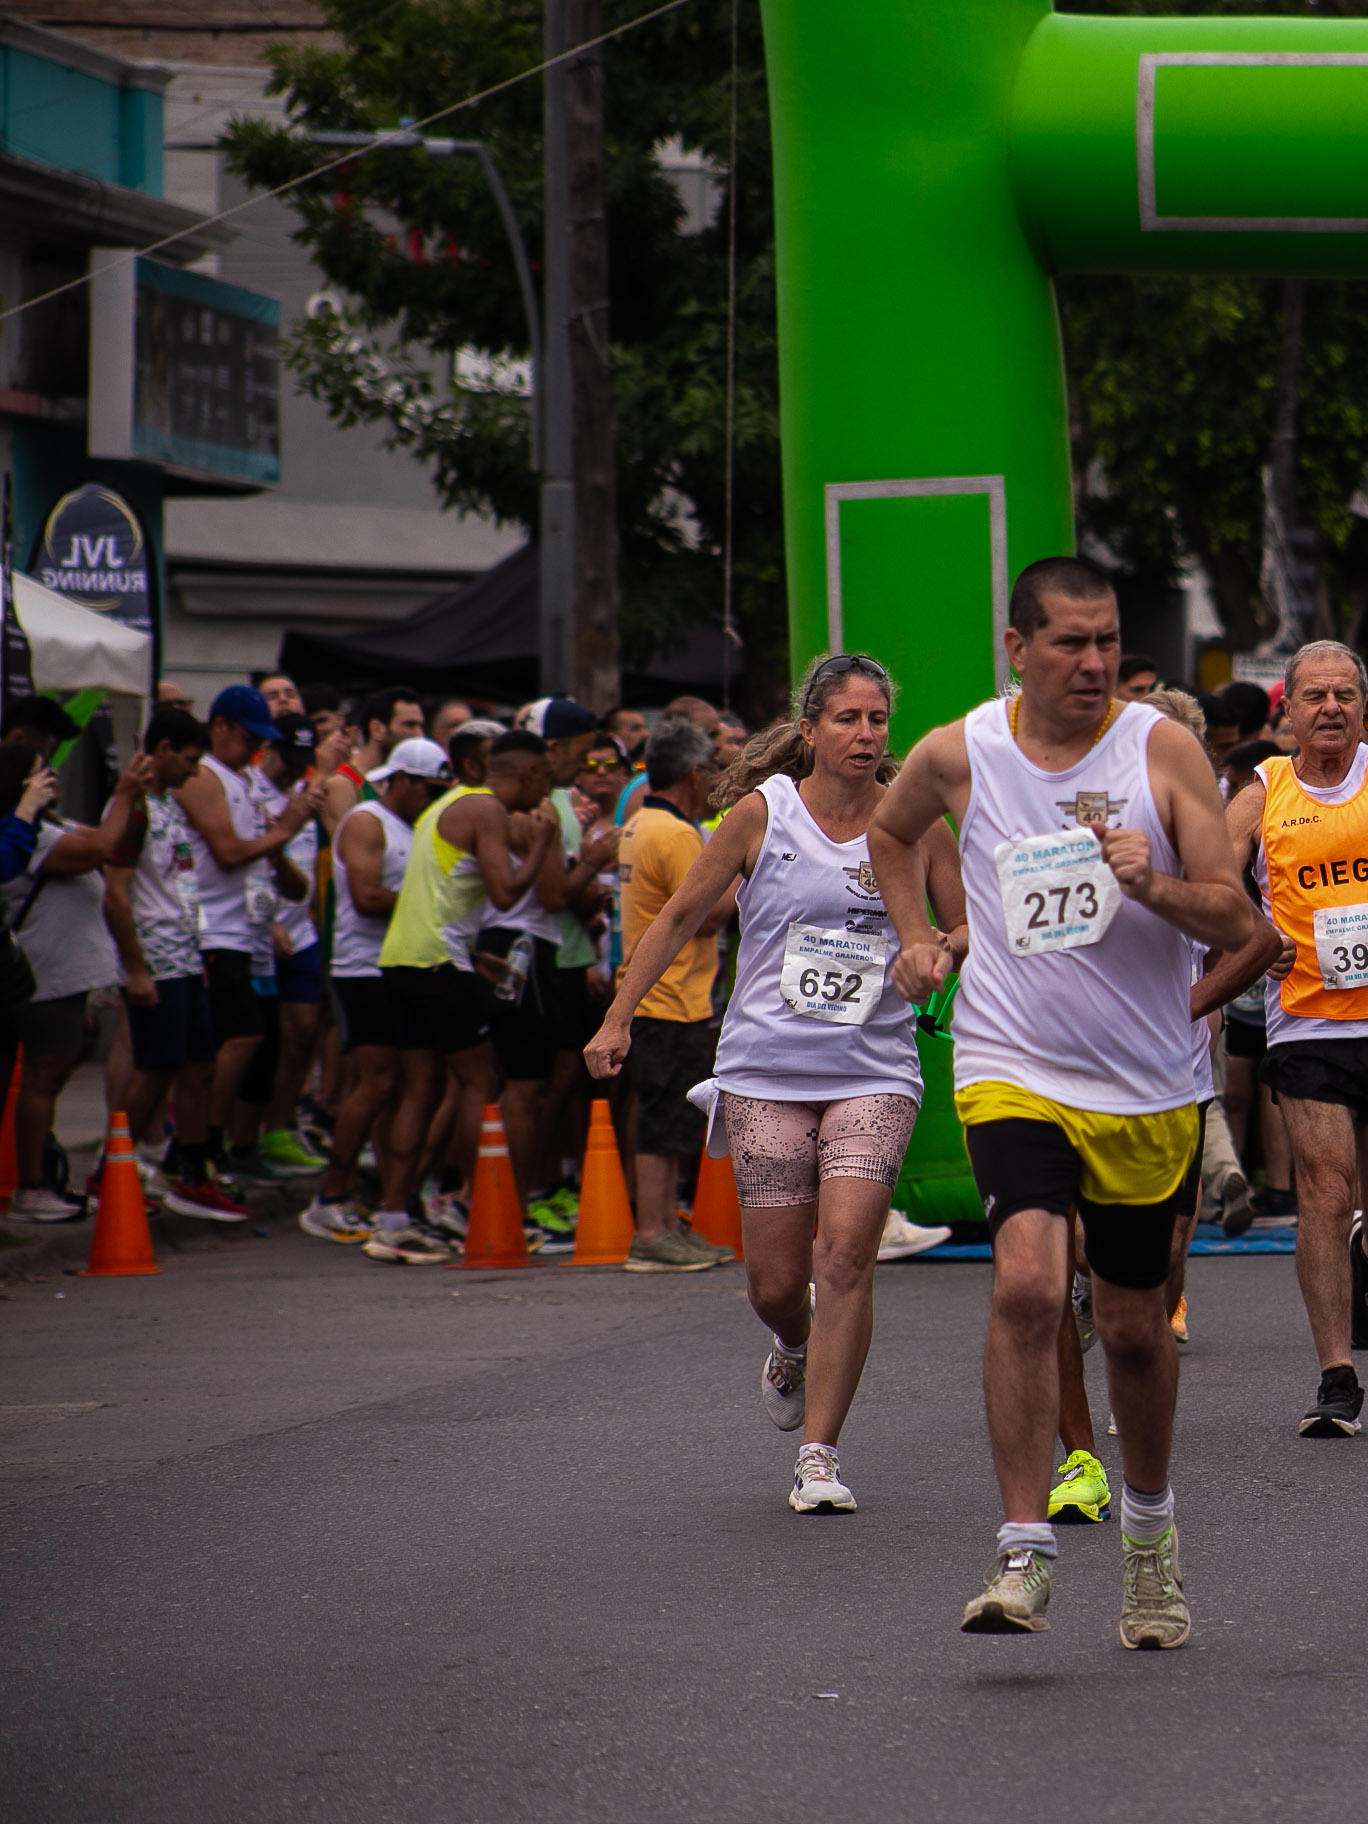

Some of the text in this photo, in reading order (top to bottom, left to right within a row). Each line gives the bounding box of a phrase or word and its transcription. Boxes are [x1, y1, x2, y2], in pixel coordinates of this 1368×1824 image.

[1016, 841, 1094, 862] 40 MARATON
[1024, 882, 1098, 930] 273
[800, 946, 874, 961] EMPALME GRANEROS
[804, 935, 870, 952] 40 MARATON
[800, 968, 862, 1003] 652
